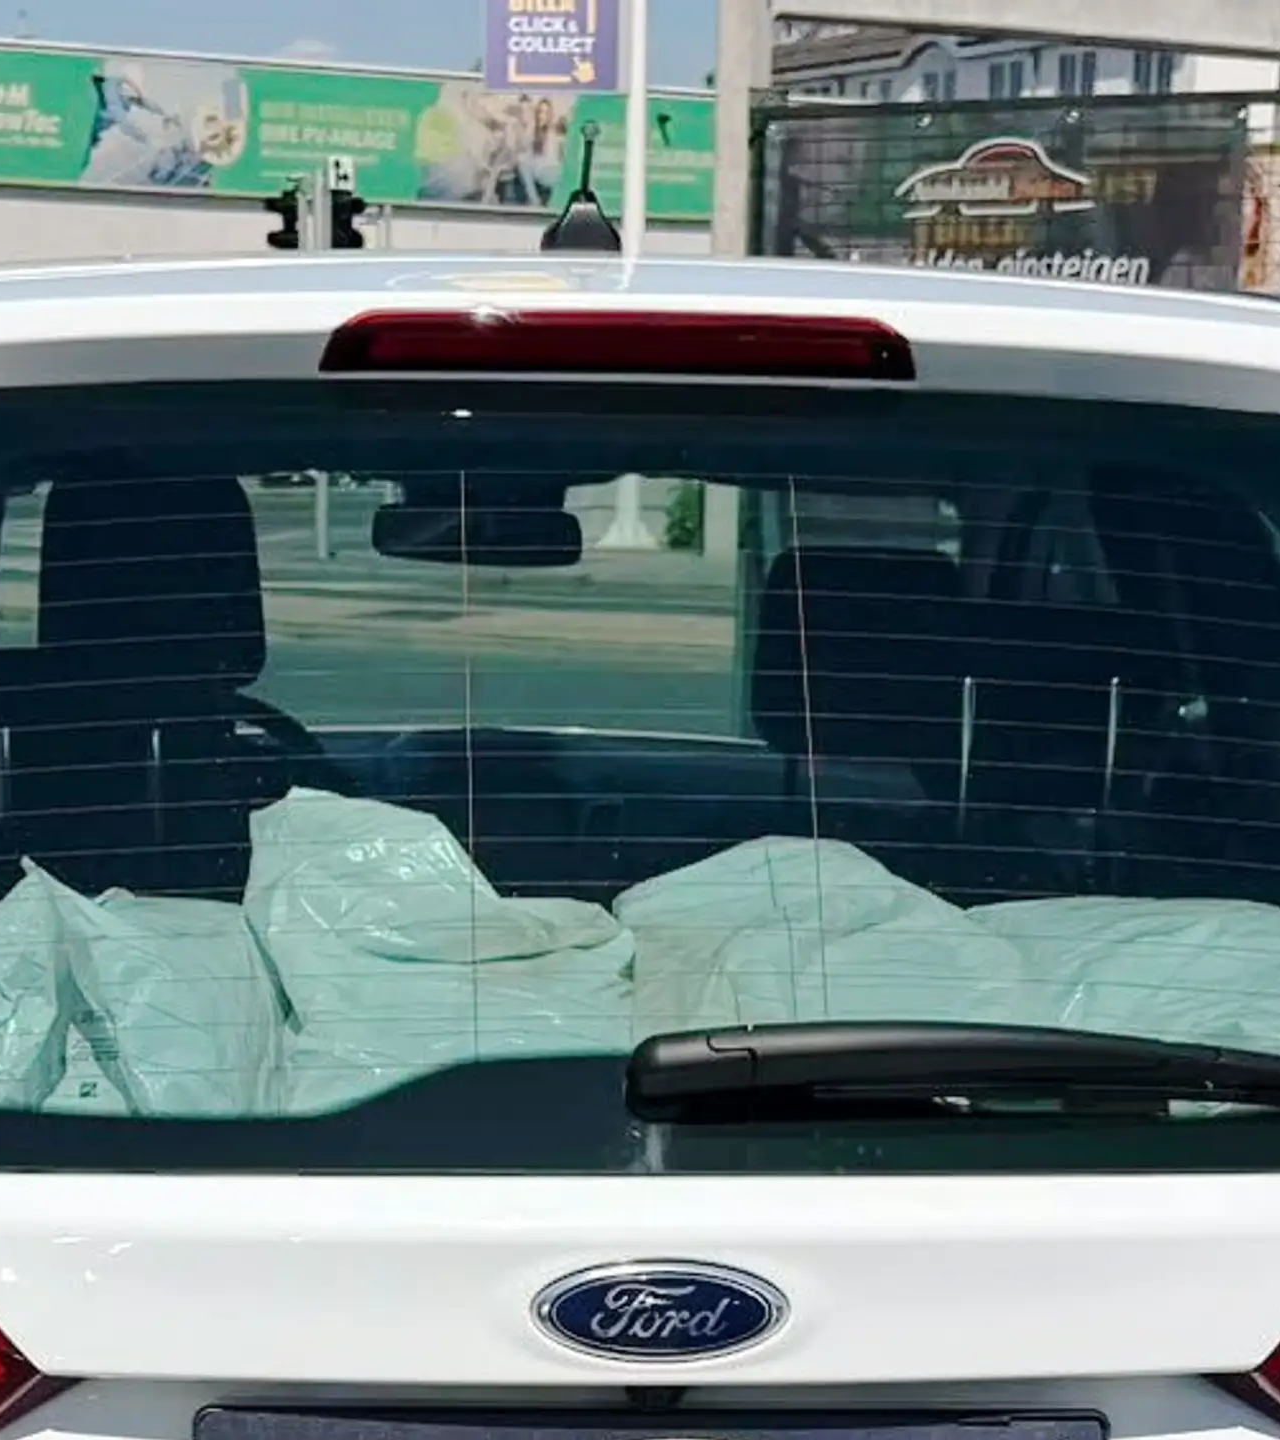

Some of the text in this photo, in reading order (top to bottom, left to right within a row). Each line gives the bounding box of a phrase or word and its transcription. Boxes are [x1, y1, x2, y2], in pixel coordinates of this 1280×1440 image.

[508, 16, 566, 32] CLICK
[508, 36, 596, 53] COLLECT
[590, 1282, 731, 1338] Ford
